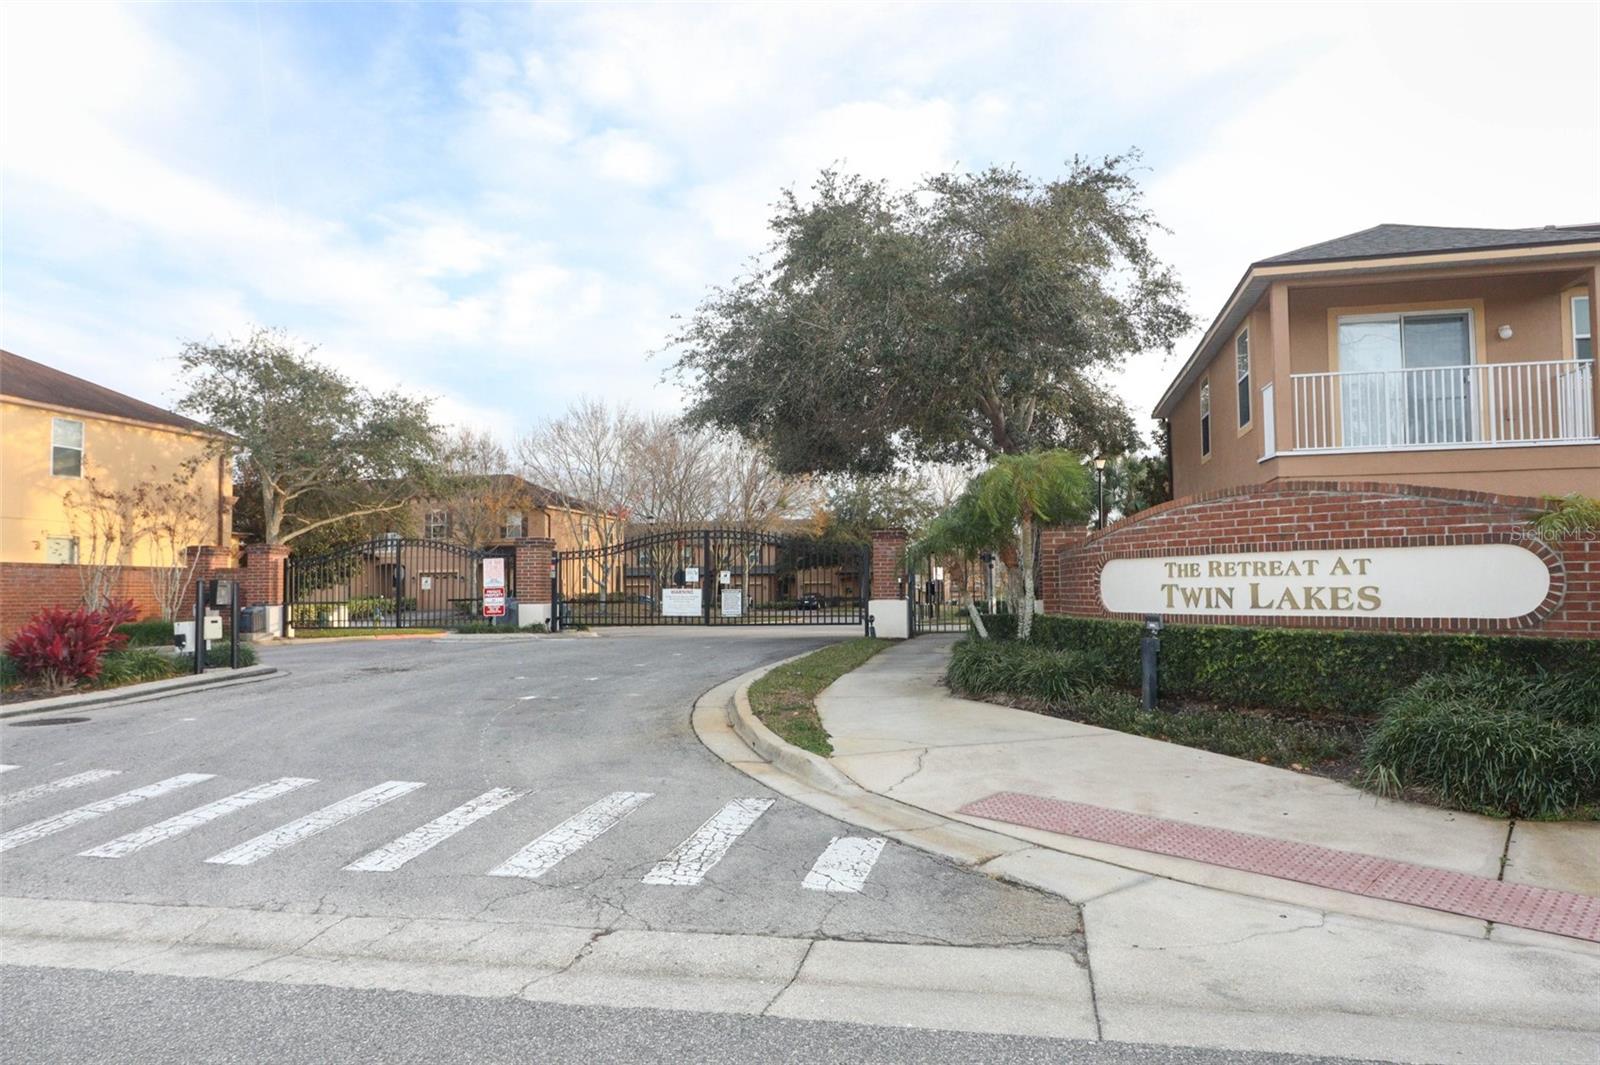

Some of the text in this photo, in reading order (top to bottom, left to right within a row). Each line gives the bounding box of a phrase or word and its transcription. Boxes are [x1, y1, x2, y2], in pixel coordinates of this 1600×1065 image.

[1165, 556, 1372, 578] THE RETREAT AT
[1161, 583, 1382, 611] TWIN LAKES
